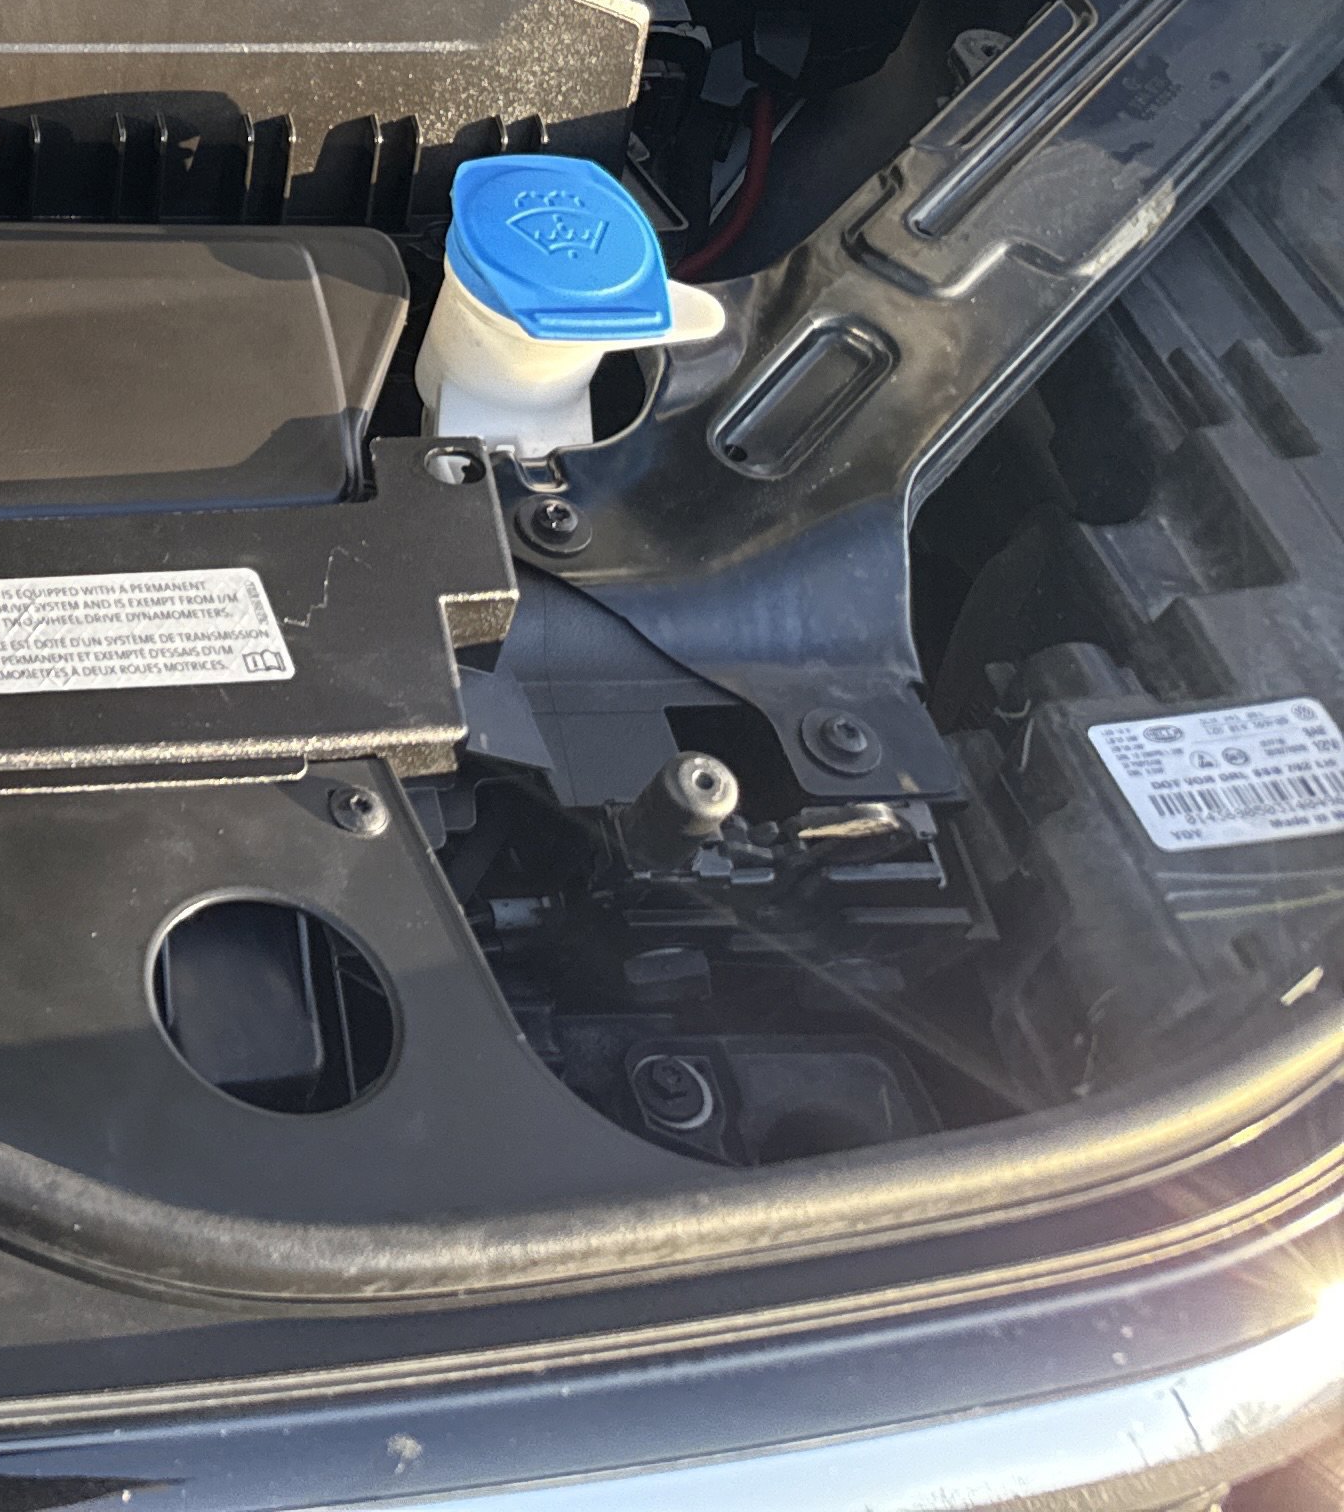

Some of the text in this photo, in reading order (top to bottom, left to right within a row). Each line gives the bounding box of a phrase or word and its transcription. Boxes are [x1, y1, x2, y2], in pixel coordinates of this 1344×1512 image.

[2, 590, 12, 600] IS
[16, 587, 78, 600] EQUIPPED
[80, 586, 116, 596] WITH
[119, 585, 129, 594] A
[130, 582, 206, 594] PERMANENT
[34, 600, 80, 613] SYSTEM
[82, 598, 112, 610] AND
[114, 598, 126, 608] IS
[128, 596, 176, 608] EXEMPT
[179, 594, 214, 605] FROM
[84, 612, 122, 623] DRIVE
[126, 608, 234, 622] DYNAMOMETERS.
[70, 636, 103, 647] D'UN
[159, 633, 176, 644] DE
[178, 628, 270, 642] TRANSMISSION
[1, 652, 78, 666] PERMANENT
[78, 652, 91, 662] ET
[148, 646, 200, 659] D'ESSAIS
[82, 664, 117, 677] DEUX
[120, 661, 162, 674] ROUES
[164, 659, 229, 672] MOTRICES.
